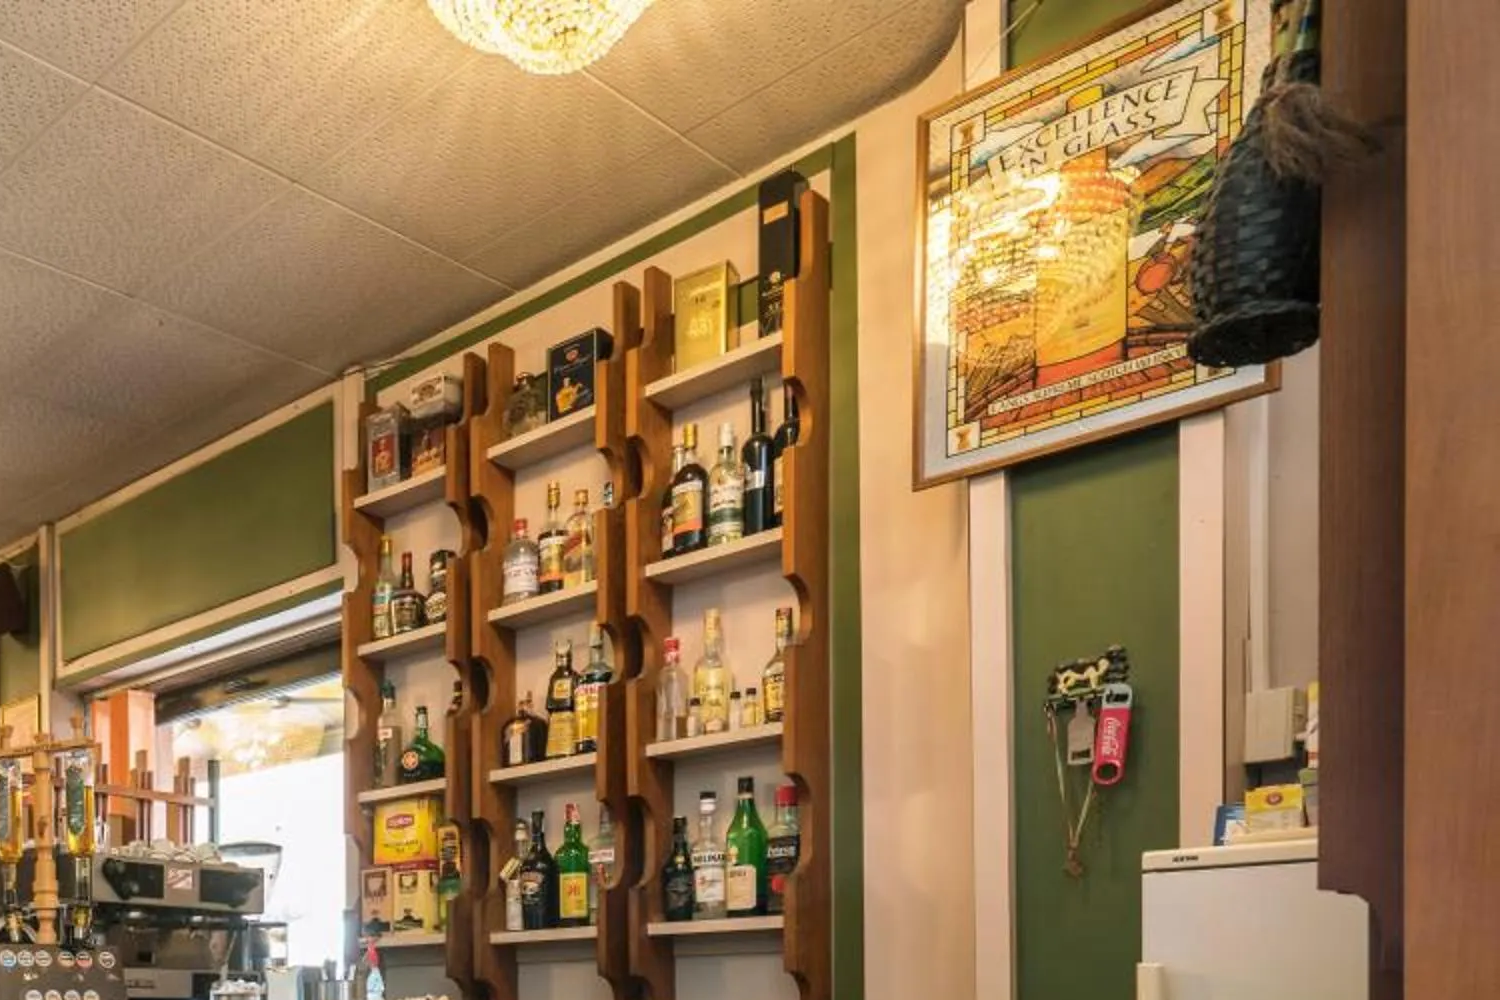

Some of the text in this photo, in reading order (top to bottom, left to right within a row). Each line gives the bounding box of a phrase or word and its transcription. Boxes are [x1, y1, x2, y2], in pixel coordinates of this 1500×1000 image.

[1000, 75, 1182, 171] EXCELLENCE
[1020, 110, 1156, 177] IN GLASS
